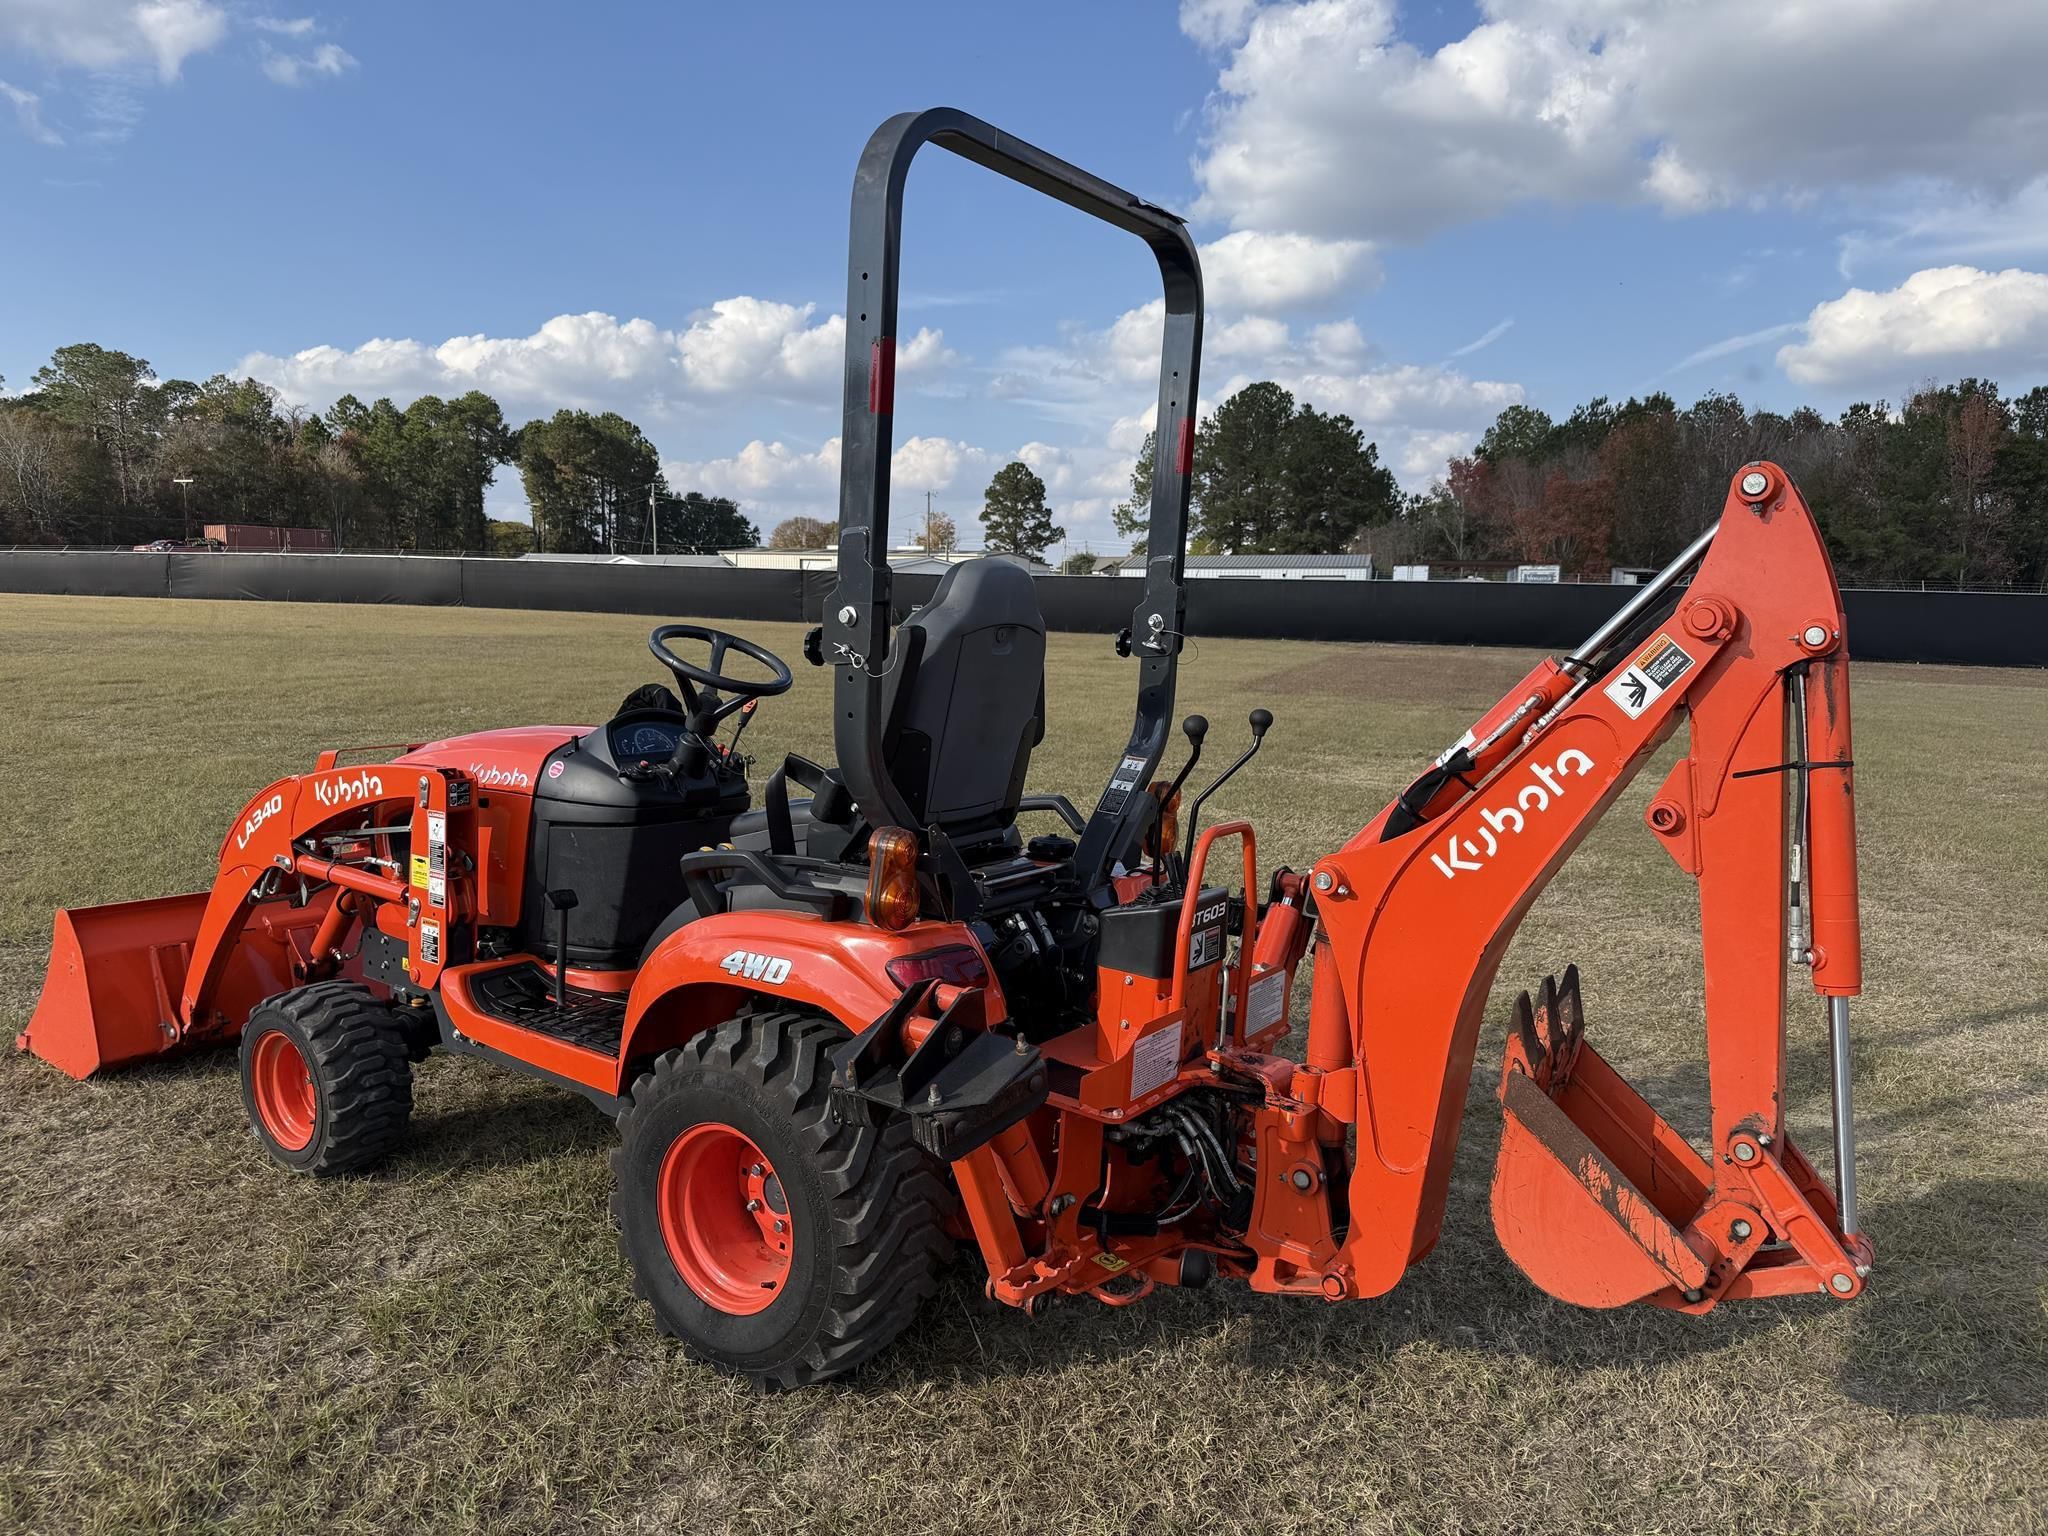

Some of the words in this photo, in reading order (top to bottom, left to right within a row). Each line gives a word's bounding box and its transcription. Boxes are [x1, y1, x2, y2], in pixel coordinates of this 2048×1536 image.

[1642, 638, 1666, 662] WARNING
[314, 770, 383, 806] Kubota
[470, 762, 528, 788] Kubota
[237, 794, 282, 850] LA340
[1430, 749, 1595, 879] Kubota
[719, 949, 793, 985] 4WD
